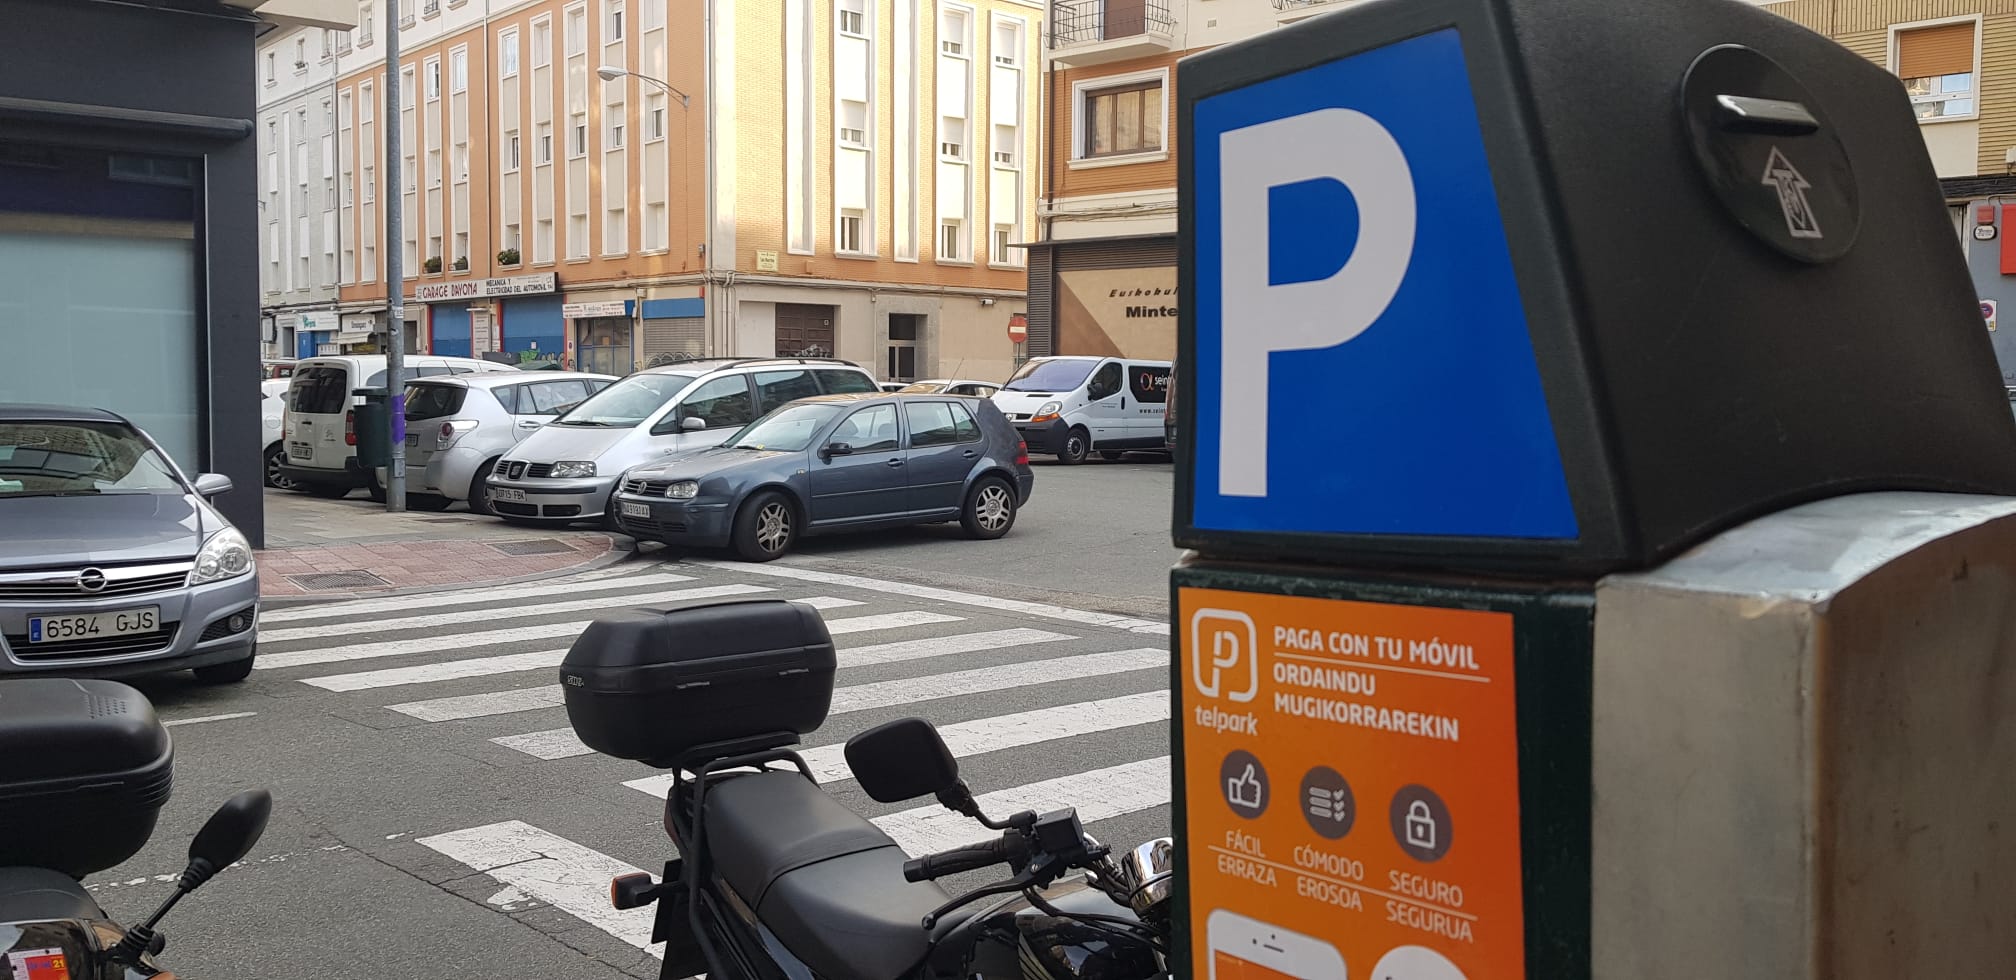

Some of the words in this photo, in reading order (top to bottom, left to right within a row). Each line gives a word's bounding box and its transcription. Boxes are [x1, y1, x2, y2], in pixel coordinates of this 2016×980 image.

[423, 285, 448, 299] GARAGE
[1219, 107, 1417, 497] P
[46, 616, 100, 638] 6584
[116, 612, 154, 632] GJS
[1274, 625, 1324, 652] PAGA
[1328, 631, 1369, 657] CON
[1374, 636, 1403, 661] TU
[1408, 636, 1480, 671] MÓVIL
[1273, 662, 1376, 697] ORDAINDU
[1195, 704, 1259, 736] telpark
[1274, 691, 1460, 742] MUGIKORRAREKIN
[1225, 829, 1267, 858] FÁCIL
[1217, 854, 1278, 888] ERRAZA
[1293, 844, 1364, 882] CÓMODO
[1296, 876, 1364, 913] EROSOA
[1389, 869, 1464, 908] SEGURO
[1386, 900, 1474, 944] SEGURUA
